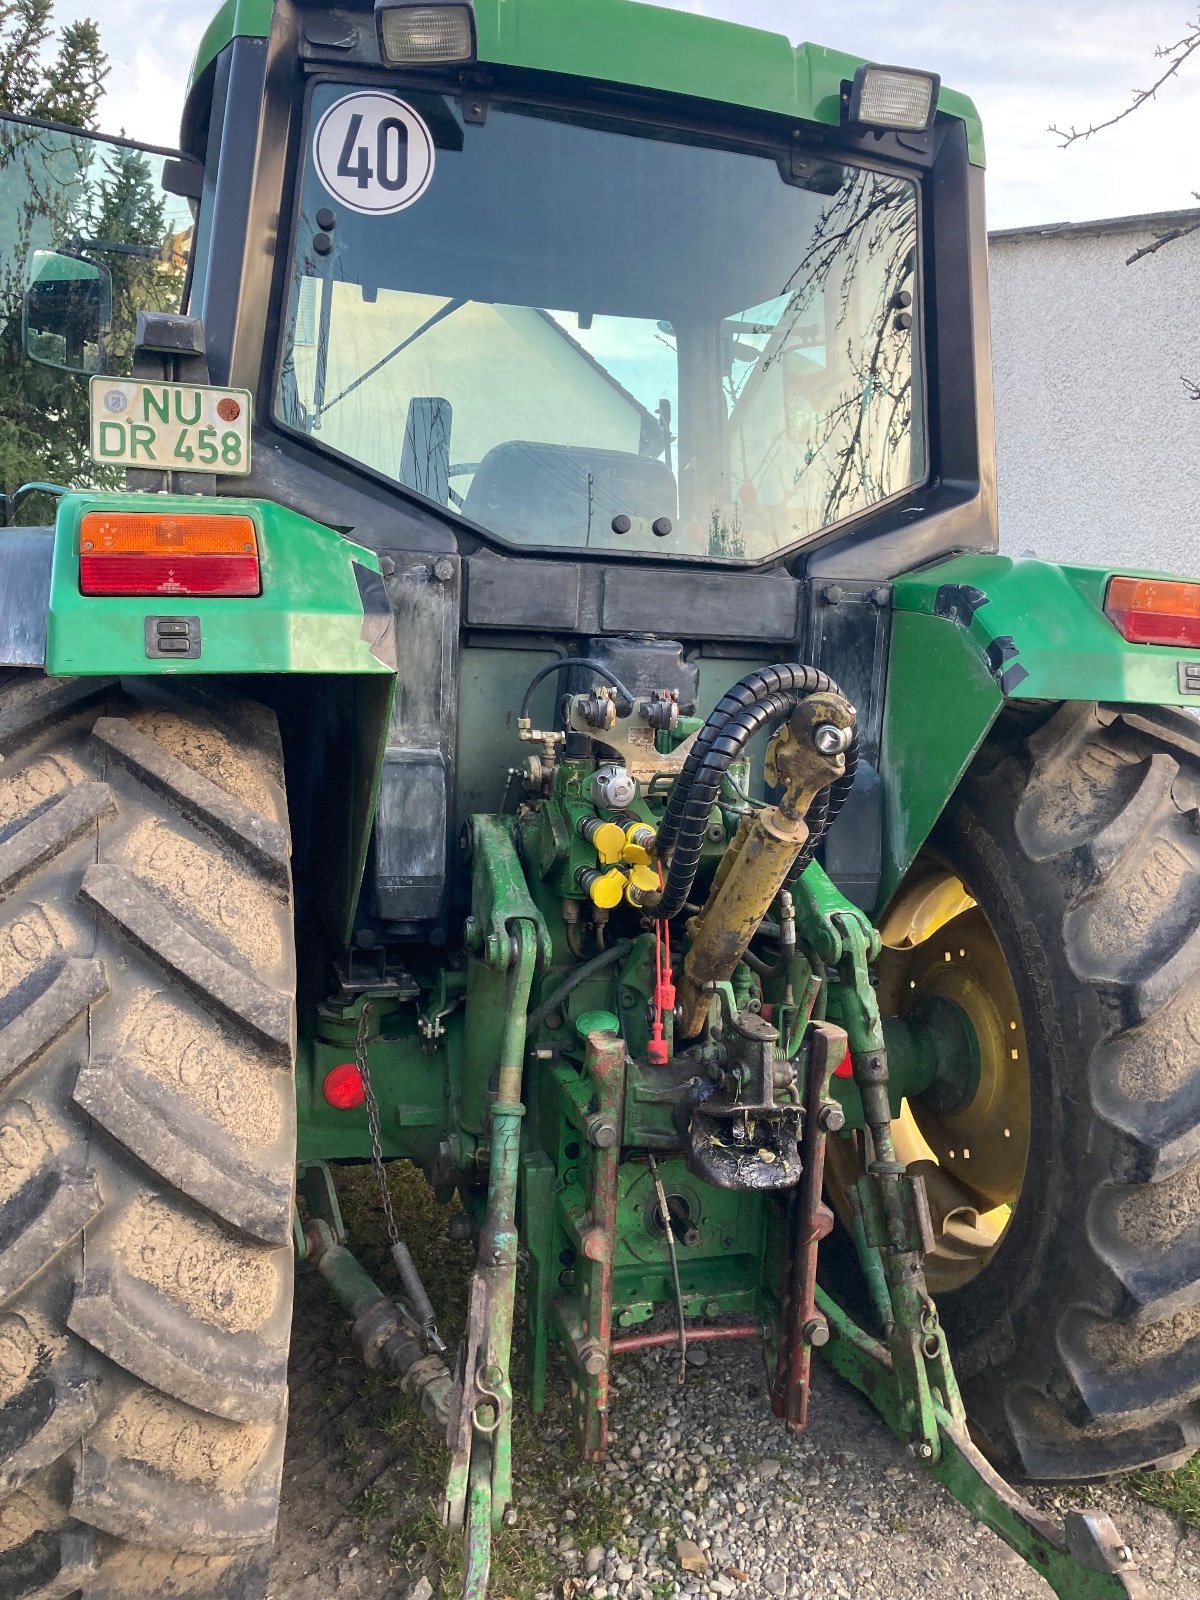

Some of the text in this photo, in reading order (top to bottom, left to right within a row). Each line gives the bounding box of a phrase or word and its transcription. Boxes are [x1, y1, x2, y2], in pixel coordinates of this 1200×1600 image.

[337, 113, 408, 191] 40
[142, 387, 202, 426] NU
[99, 421, 242, 466] DR 458
